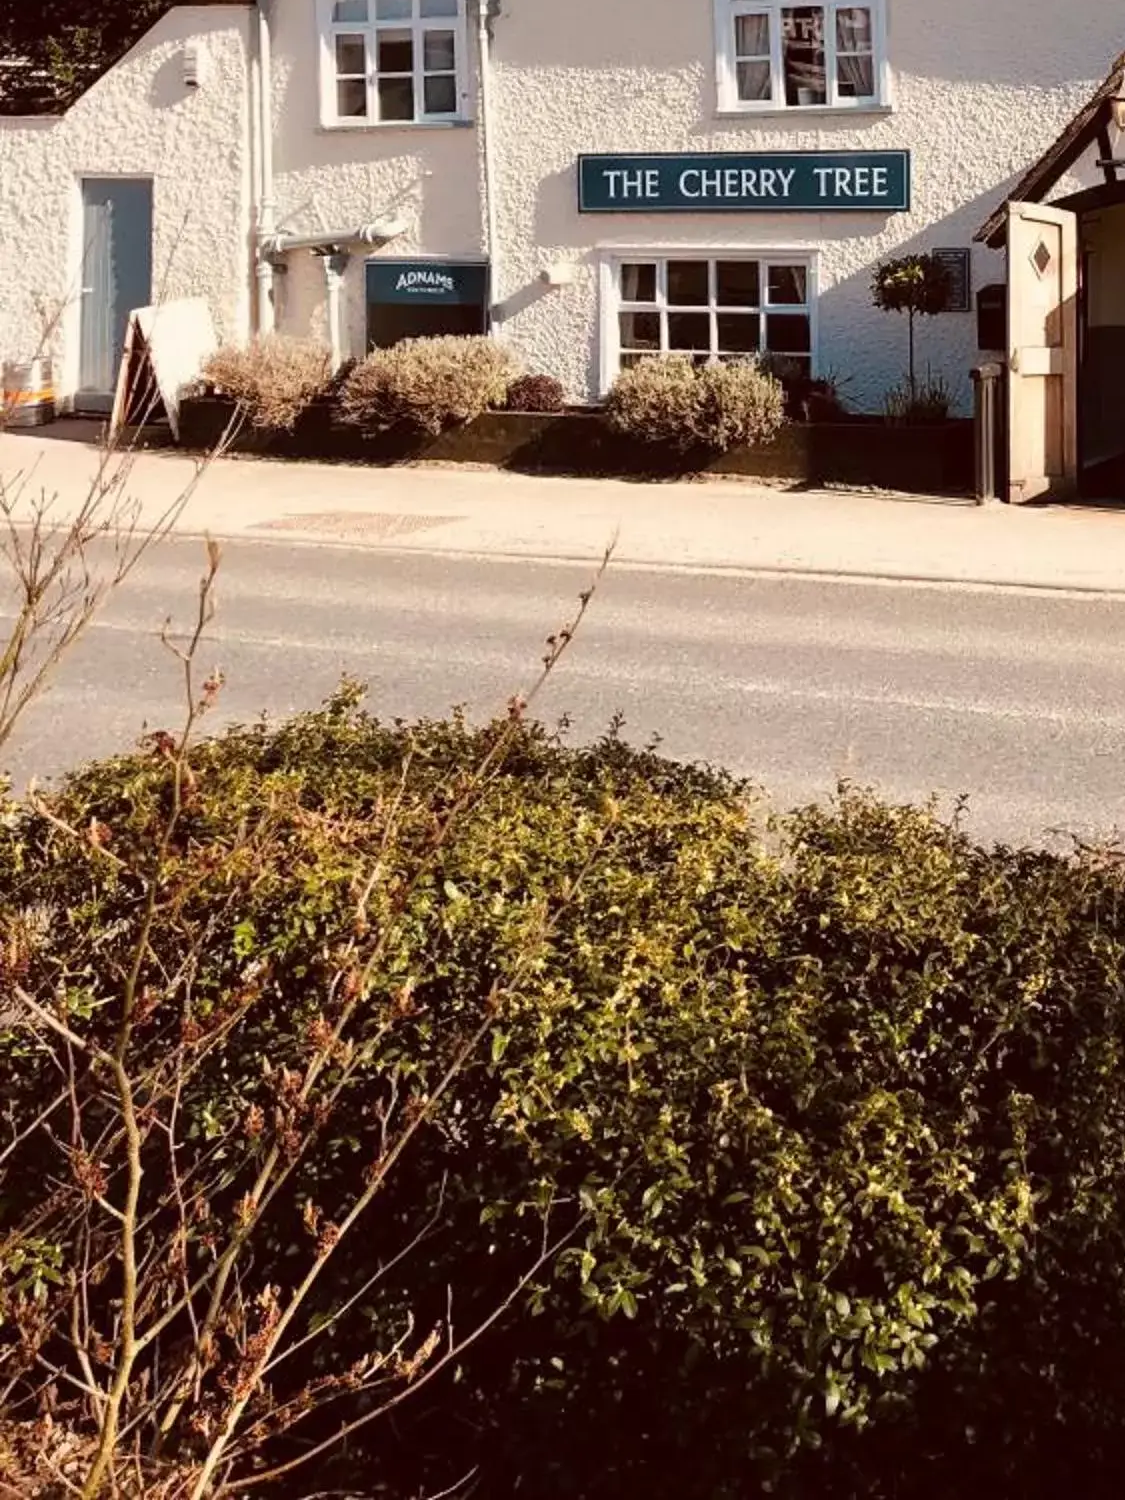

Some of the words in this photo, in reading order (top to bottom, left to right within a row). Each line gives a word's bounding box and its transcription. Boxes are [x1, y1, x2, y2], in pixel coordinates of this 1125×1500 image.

[602, 169, 661, 198] THE
[679, 168, 796, 198] CHERRY
[812, 167, 889, 197] TREE
[395, 271, 455, 291] ADNAMS
